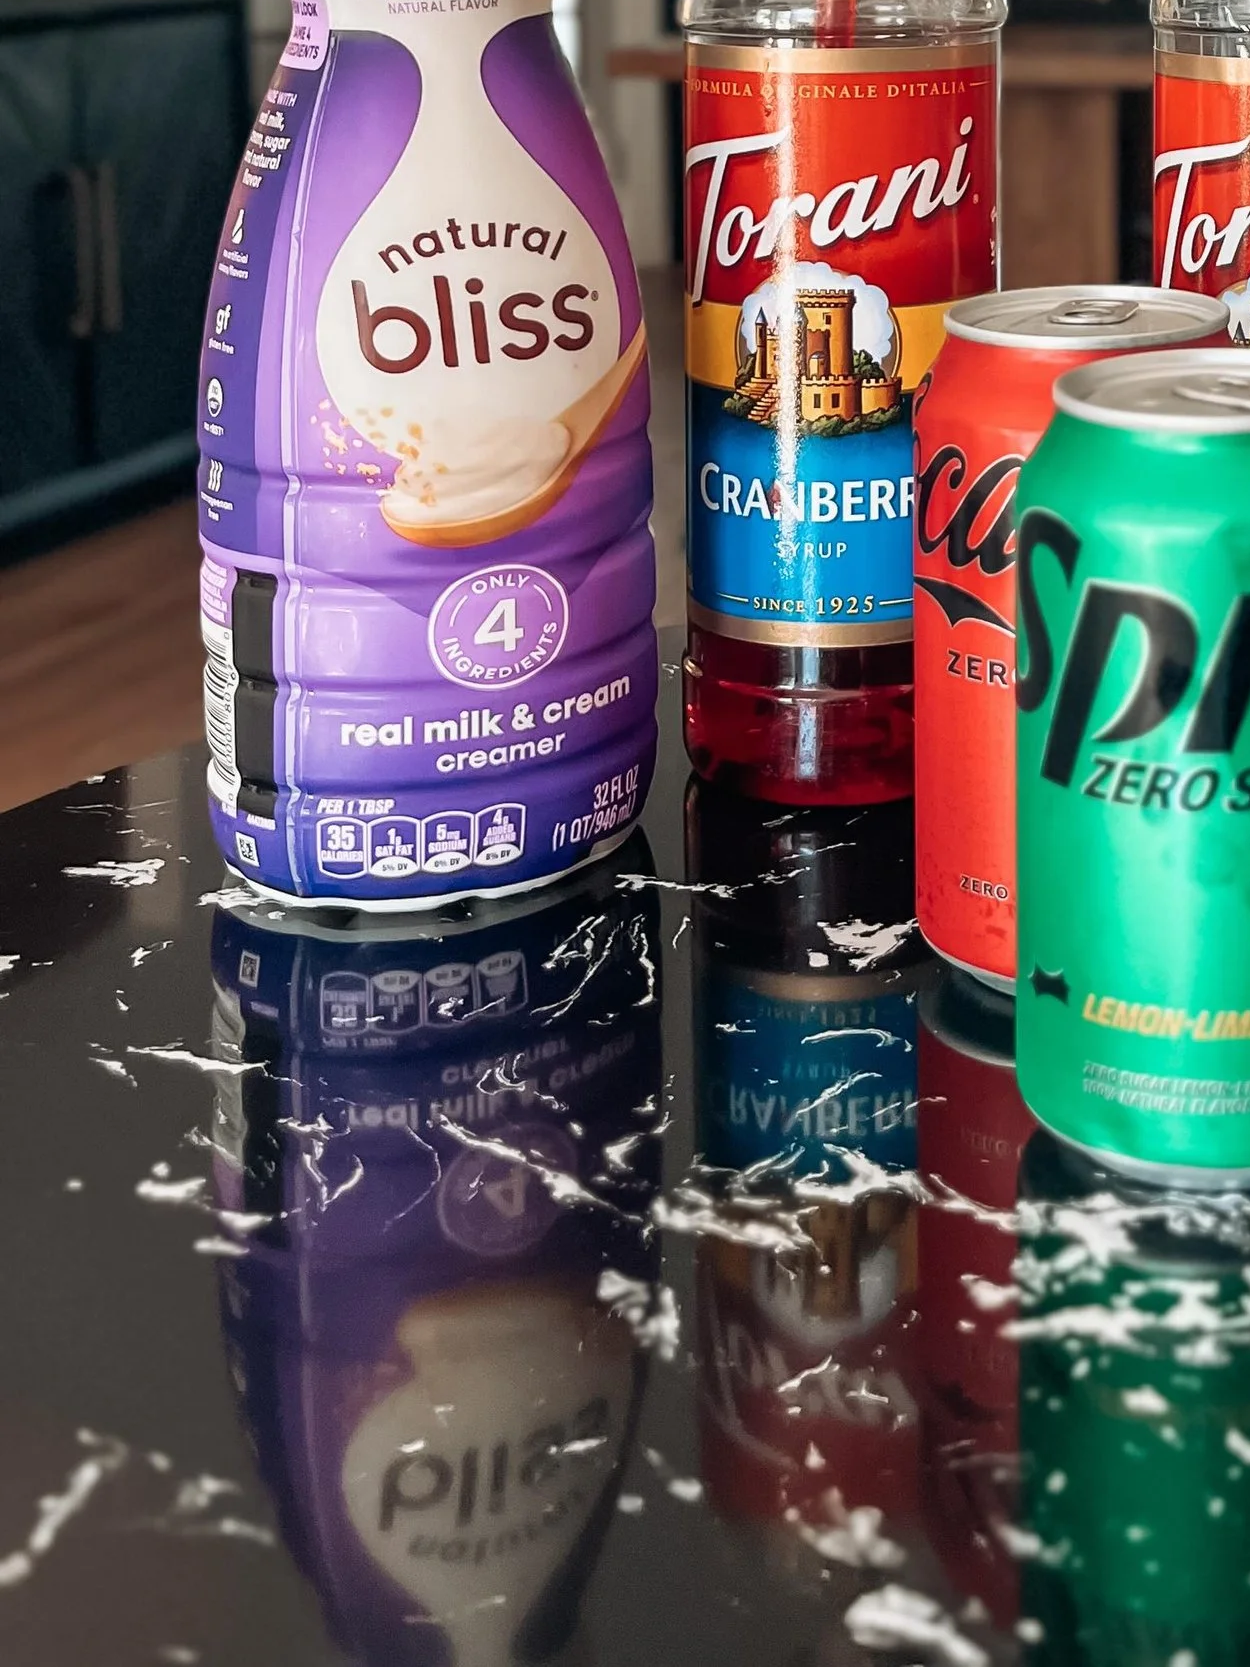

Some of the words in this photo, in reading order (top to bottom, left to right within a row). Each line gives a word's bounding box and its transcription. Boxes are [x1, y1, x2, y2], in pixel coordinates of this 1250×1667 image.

[388, 0, 446, 15] NATURAL
[887, 81, 966, 99] D'ITALIA
[685, 116, 974, 308] Torani
[378, 218, 568, 274] natural
[215, 303, 232, 335] gf
[351, 275, 595, 374] bliss
[775, 540, 848, 560] SYRUP
[471, 573, 530, 594] ONLY
[752, 596, 806, 615] SINCE
[815, 595, 875, 615] 1925
[474, 597, 525, 652] 4
[442, 621, 558, 680] INGREDIENTS
[946, 650, 1017, 687] ZER
[341, 716, 413, 747] real
[423, 709, 504, 744] milk
[511, 703, 536, 731] &
[543, 675, 630, 724] cream
[436, 732, 566, 773] creamer
[593, 781, 609, 810] 32
[611, 774, 624, 803] FL
[626, 764, 639, 794] OZ
[1083, 753, 1221, 811] ZERO
[317, 798, 344, 814] PER
[346, 800, 355, 814] 1
[359, 799, 395, 815] TBSP
[327, 824, 356, 851] 35
[552, 822, 566, 852] (1
[569, 804, 618, 843] QT/946
[321, 849, 364, 862] CALORIES
[375, 845, 394, 858] SAT
[395, 843, 415, 856] FAT
[428, 838, 467, 854] SODIUM
[959, 874, 1009, 901] ZERO
